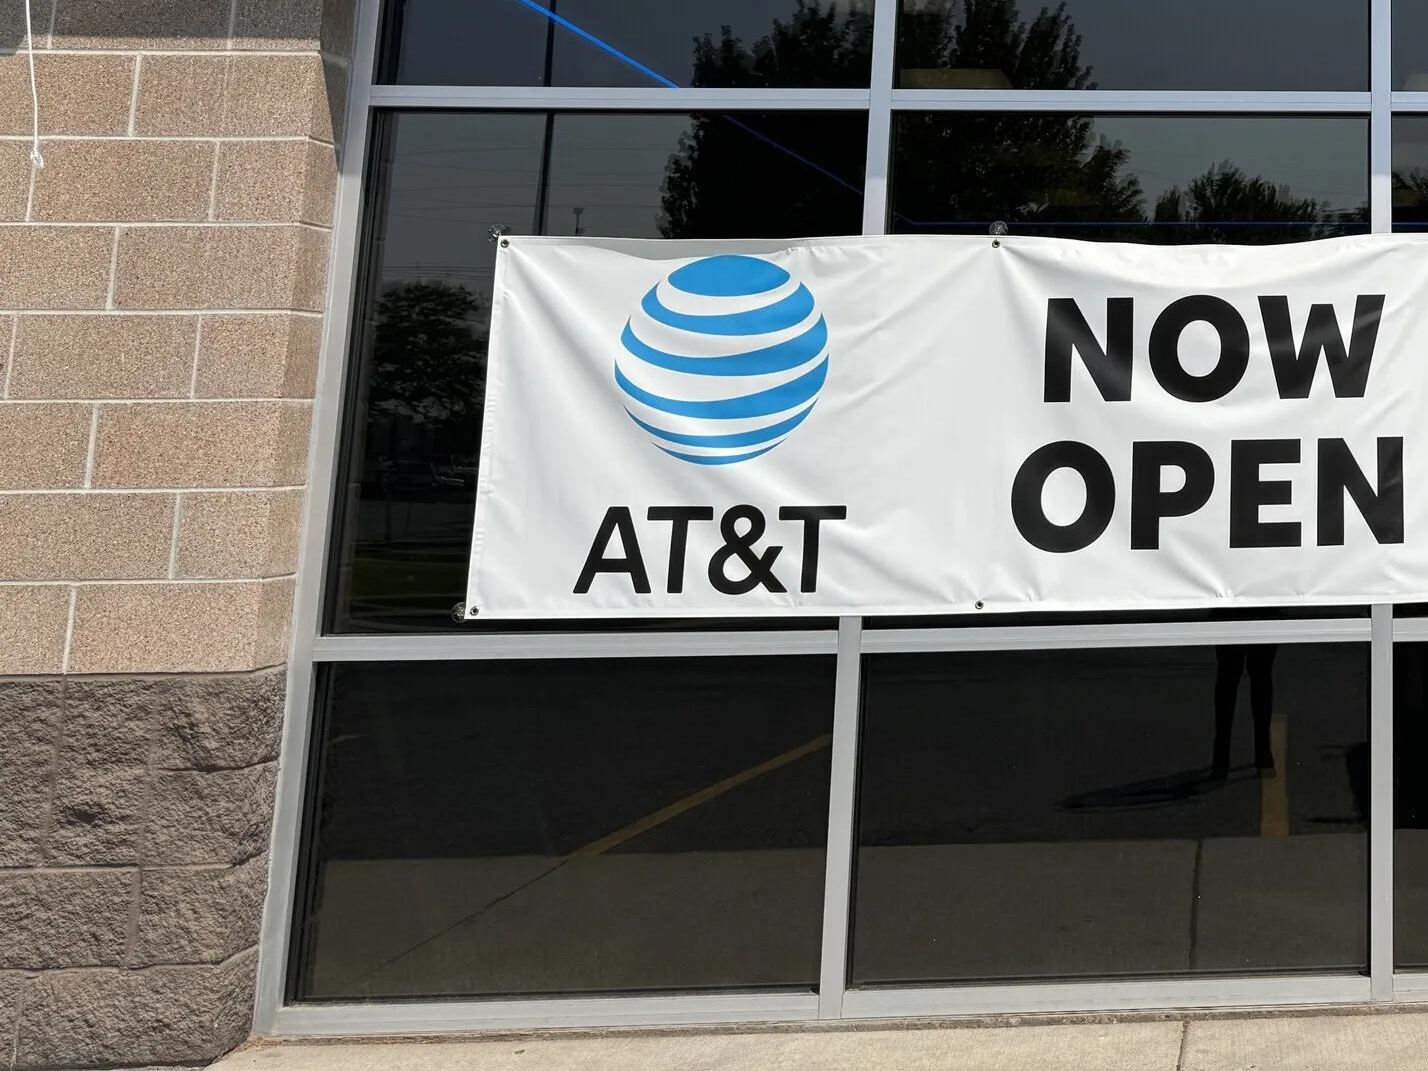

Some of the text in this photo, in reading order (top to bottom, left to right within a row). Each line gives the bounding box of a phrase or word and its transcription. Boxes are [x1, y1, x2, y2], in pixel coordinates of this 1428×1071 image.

[1043, 293, 1387, 403] NOW
[1011, 436, 1405, 554] OPEN
[572, 505, 848, 596] AT&T
